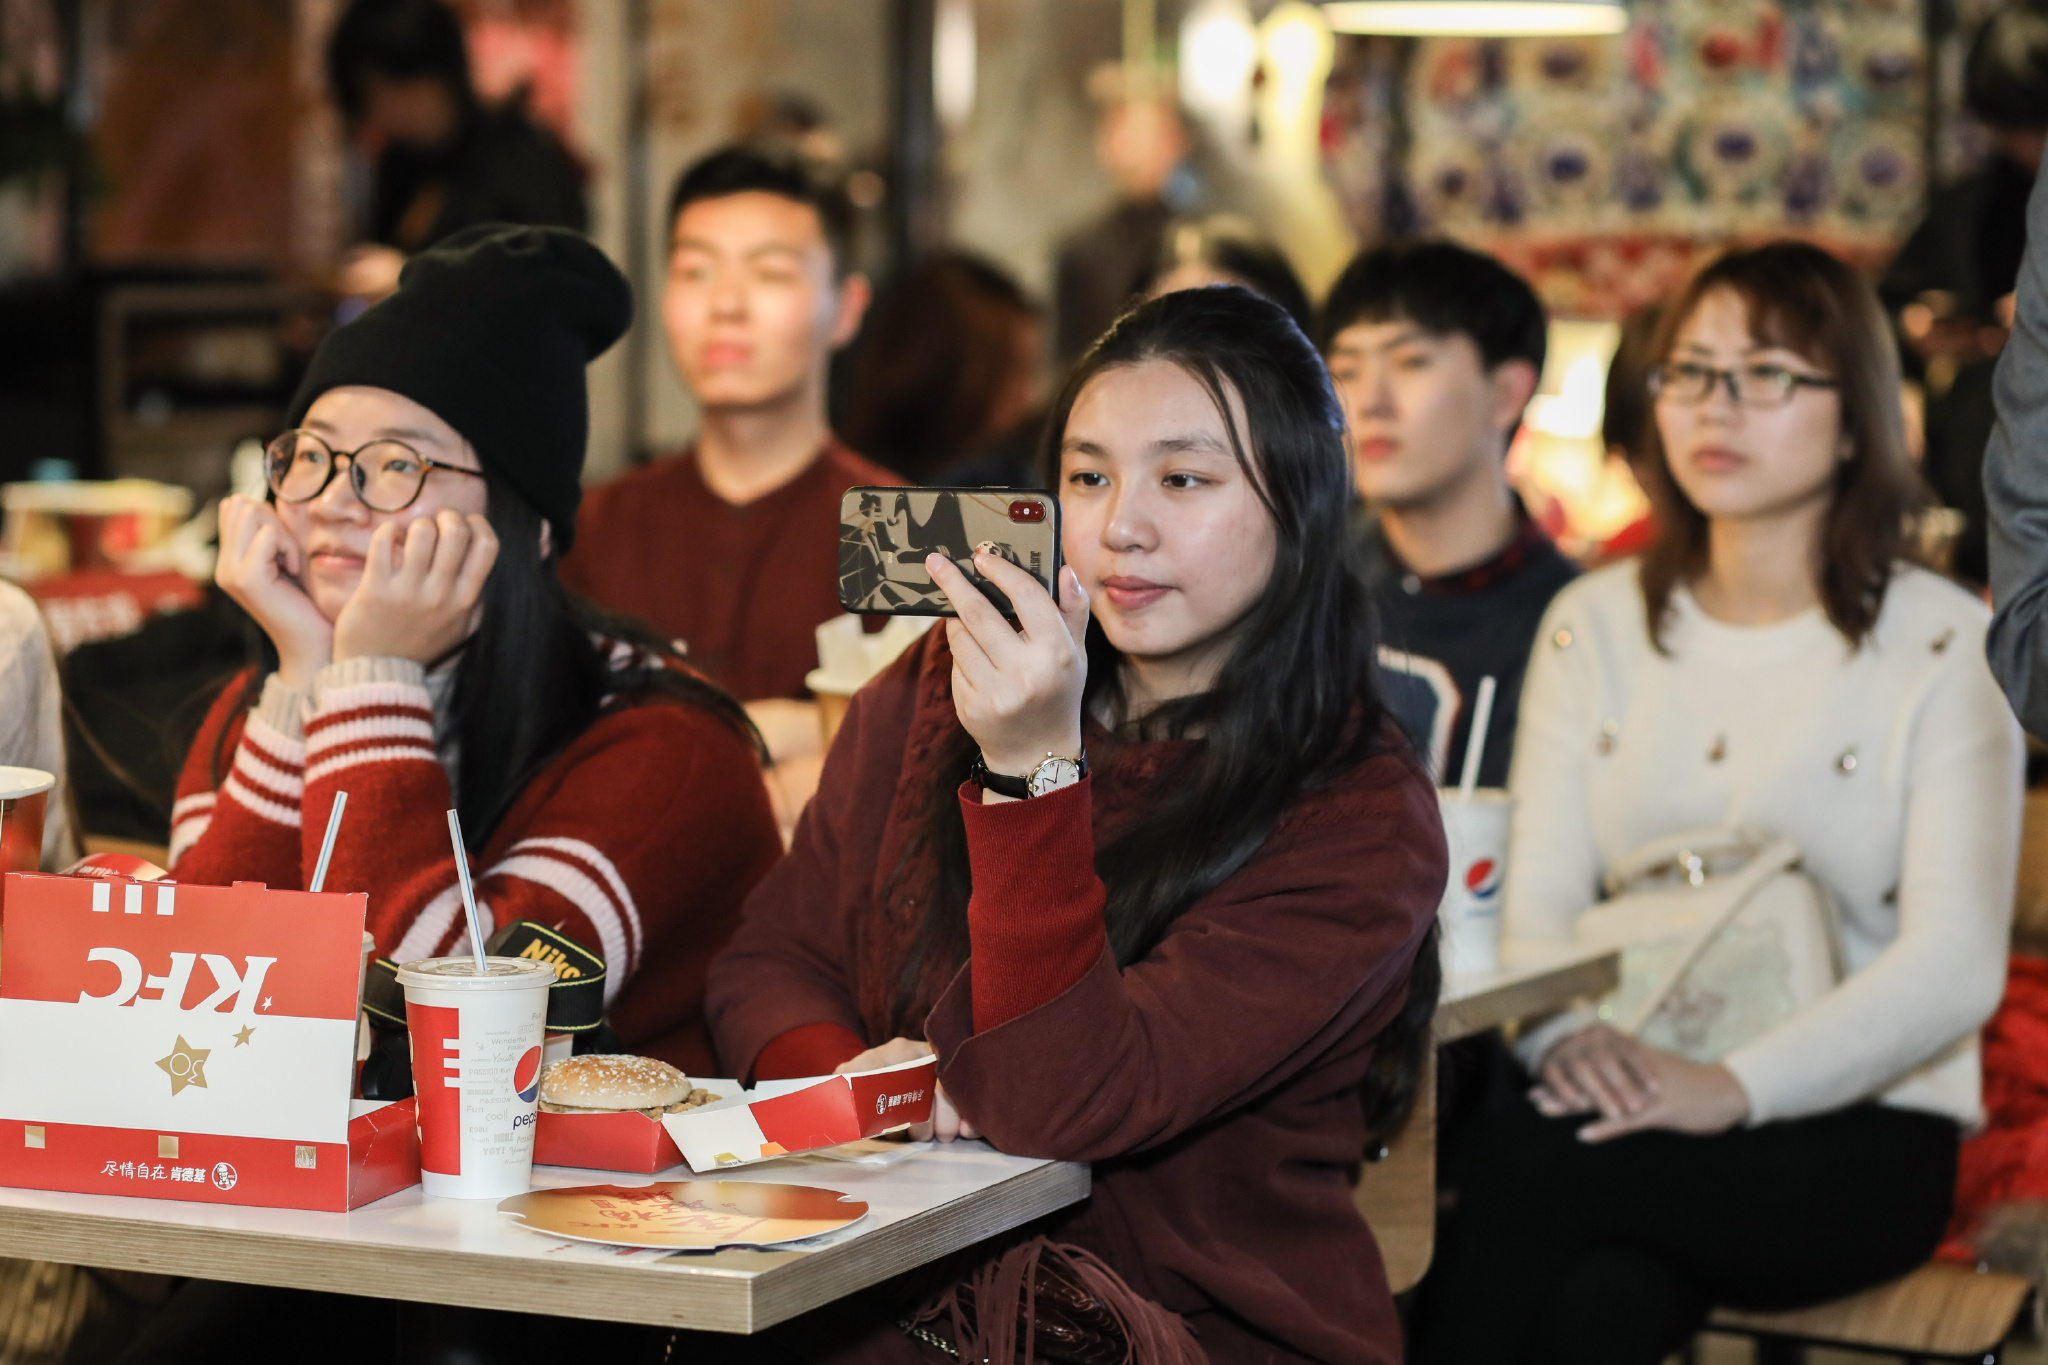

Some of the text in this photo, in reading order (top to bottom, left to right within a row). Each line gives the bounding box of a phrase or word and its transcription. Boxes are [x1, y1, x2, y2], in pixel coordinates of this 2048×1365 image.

[519, 938, 585, 979] Niko
[79, 946, 278, 1015] KFC
[491, 1036, 527, 1045] Wonderful
[493, 1053, 516, 1064] Youth
[466, 1105, 484, 1113] Fun
[512, 1111, 537, 1131] peps
[100, 1160, 207, 1184] 尽情自在 肯德基
